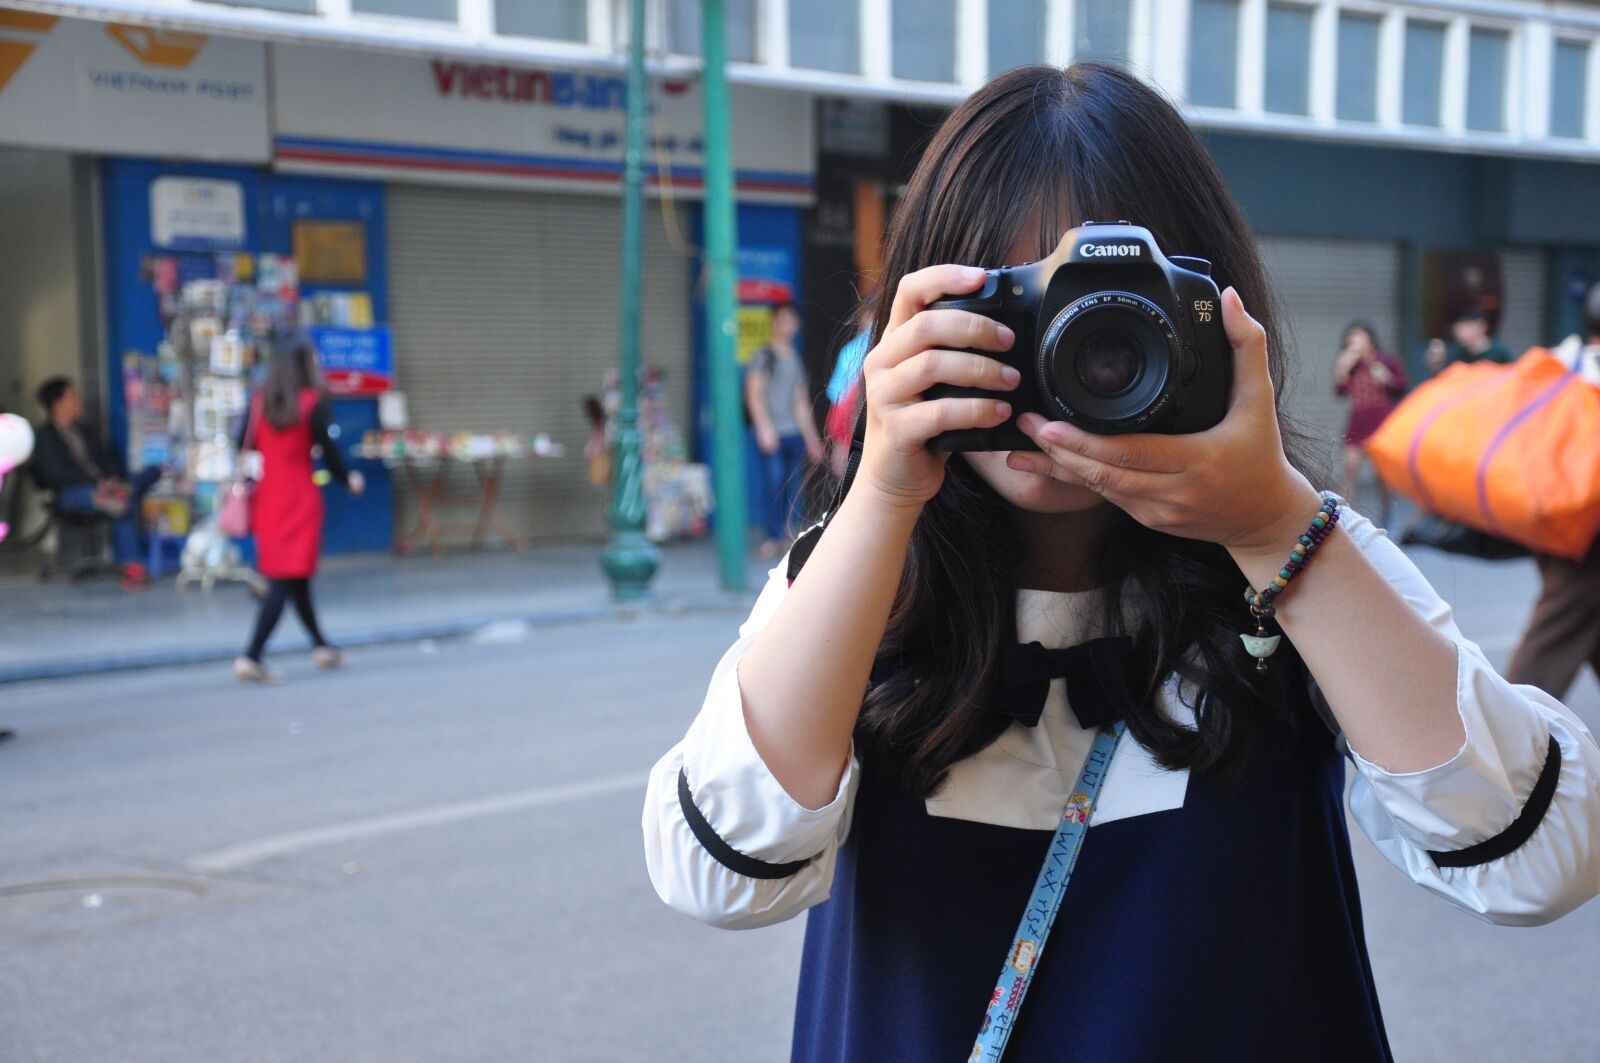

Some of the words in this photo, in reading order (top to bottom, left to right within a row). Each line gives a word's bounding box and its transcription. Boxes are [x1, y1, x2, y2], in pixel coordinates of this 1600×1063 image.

[430, 58, 652, 112] VietinBan
[1079, 243, 1141, 257] Canon
[1058, 306, 1079, 327] CANON
[1081, 298, 1098, 309] LENS
[1117, 296, 1138, 306] 50mm
[1194, 300, 1214, 311] EOS
[1198, 312, 1212, 322] 7D
